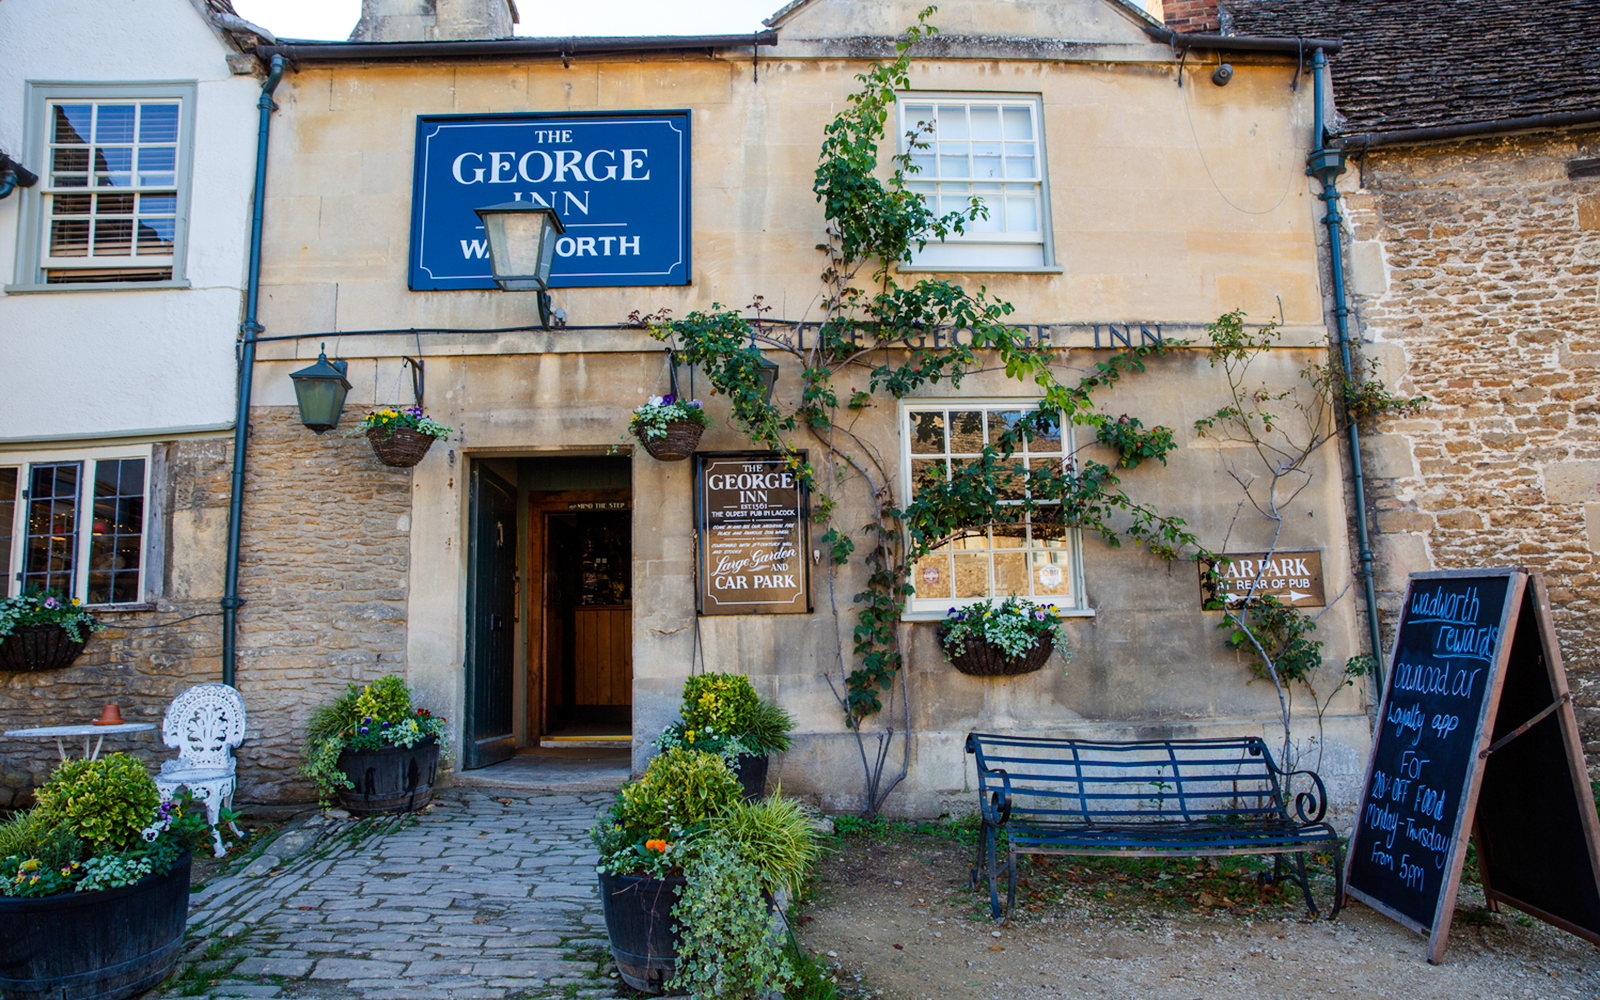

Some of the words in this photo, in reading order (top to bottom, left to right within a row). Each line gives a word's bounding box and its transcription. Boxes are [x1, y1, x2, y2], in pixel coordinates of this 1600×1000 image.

[535, 130, 573, 143] THE
[452, 149, 650, 185] GEORGE
[460, 235, 640, 259] WORTH
[1094, 324, 1162, 348] INN
[742, 464, 763, 473] THE
[709, 473, 794, 490] GEORGE
[740, 490, 768, 503] INN
[711, 555, 750, 576] Large
[750, 547, 797, 567] Garden
[770, 563, 789, 571] AND
[715, 575, 748, 590] CAR
[753, 574, 797, 589] PARK
[1271, 579, 1286, 588] OF
[1289, 578, 1311, 588] PUB
[1431, 713, 1459, 740] app
[1399, 854, 1425, 892] 5pm
